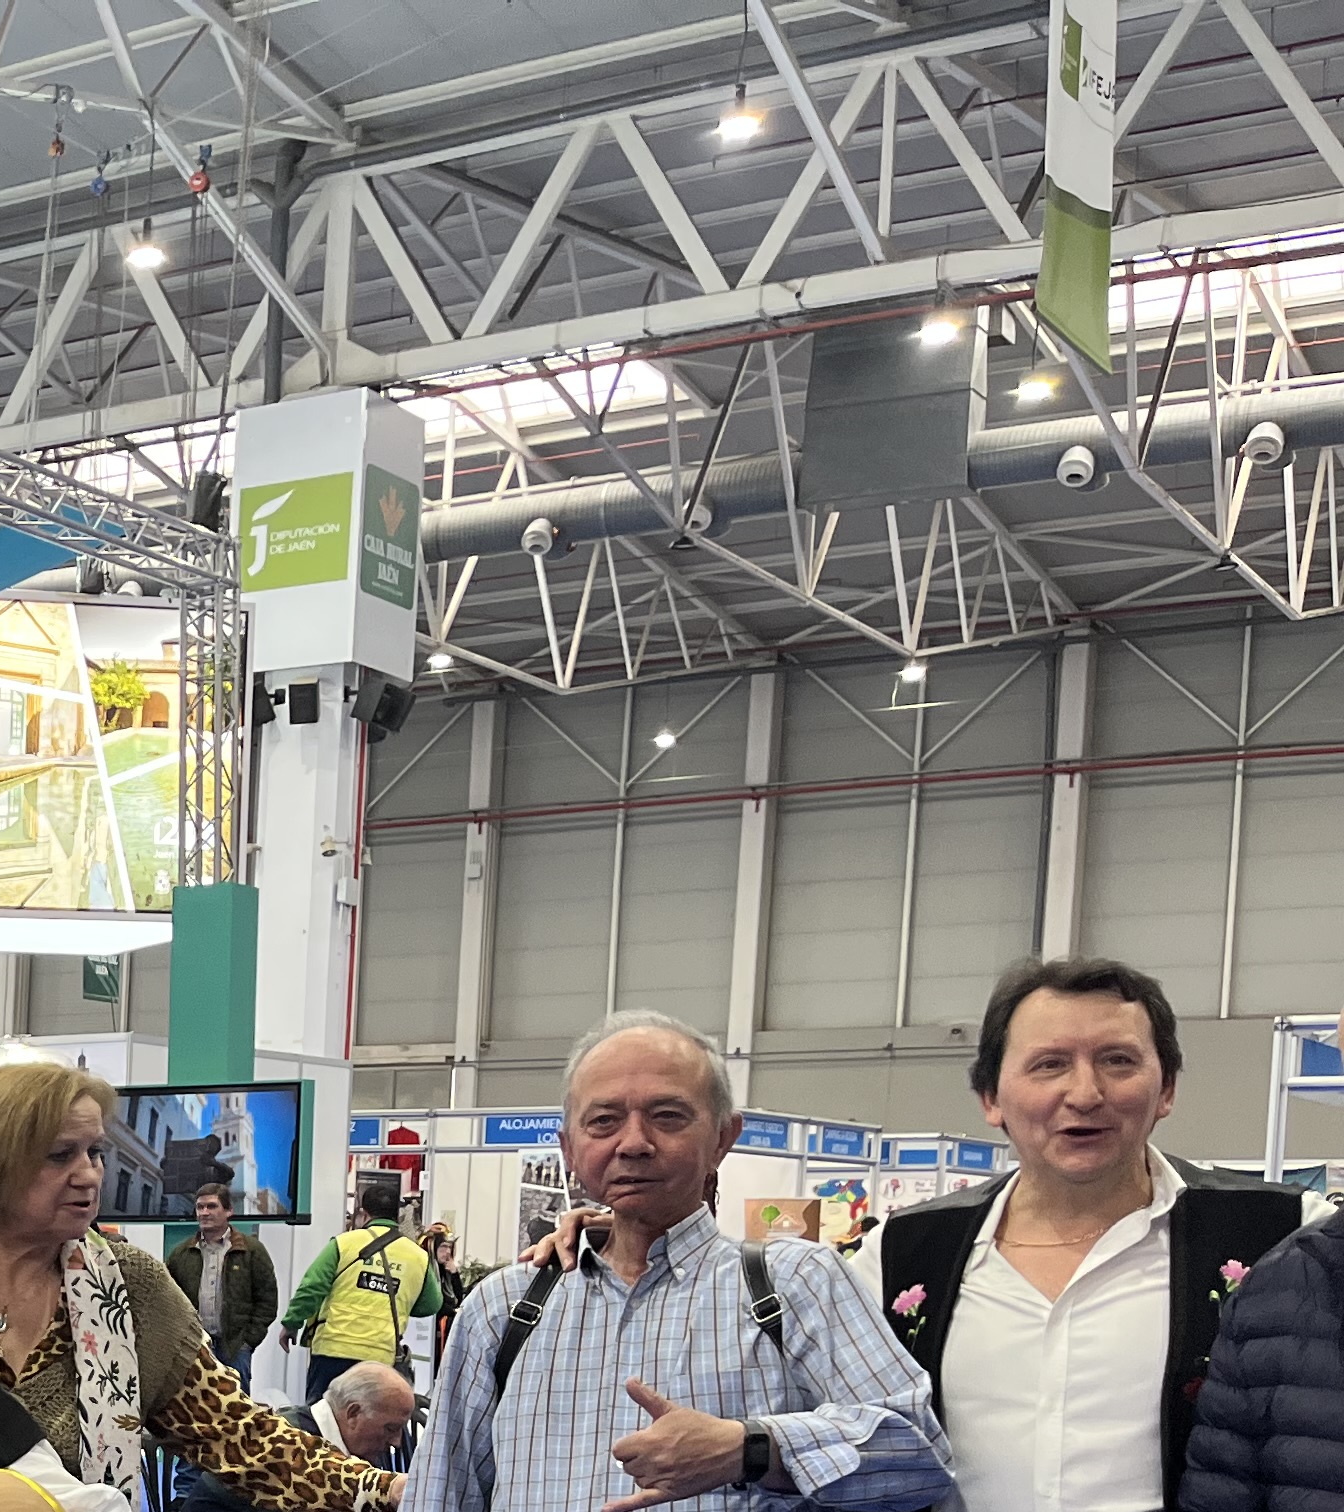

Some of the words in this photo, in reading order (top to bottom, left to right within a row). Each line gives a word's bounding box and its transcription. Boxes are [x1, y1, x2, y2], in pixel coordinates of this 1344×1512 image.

[270, 523, 340, 542] DIPUTACIÓN
[270, 544, 286, 555] DE
[288, 540, 315, 553] JAÉN
